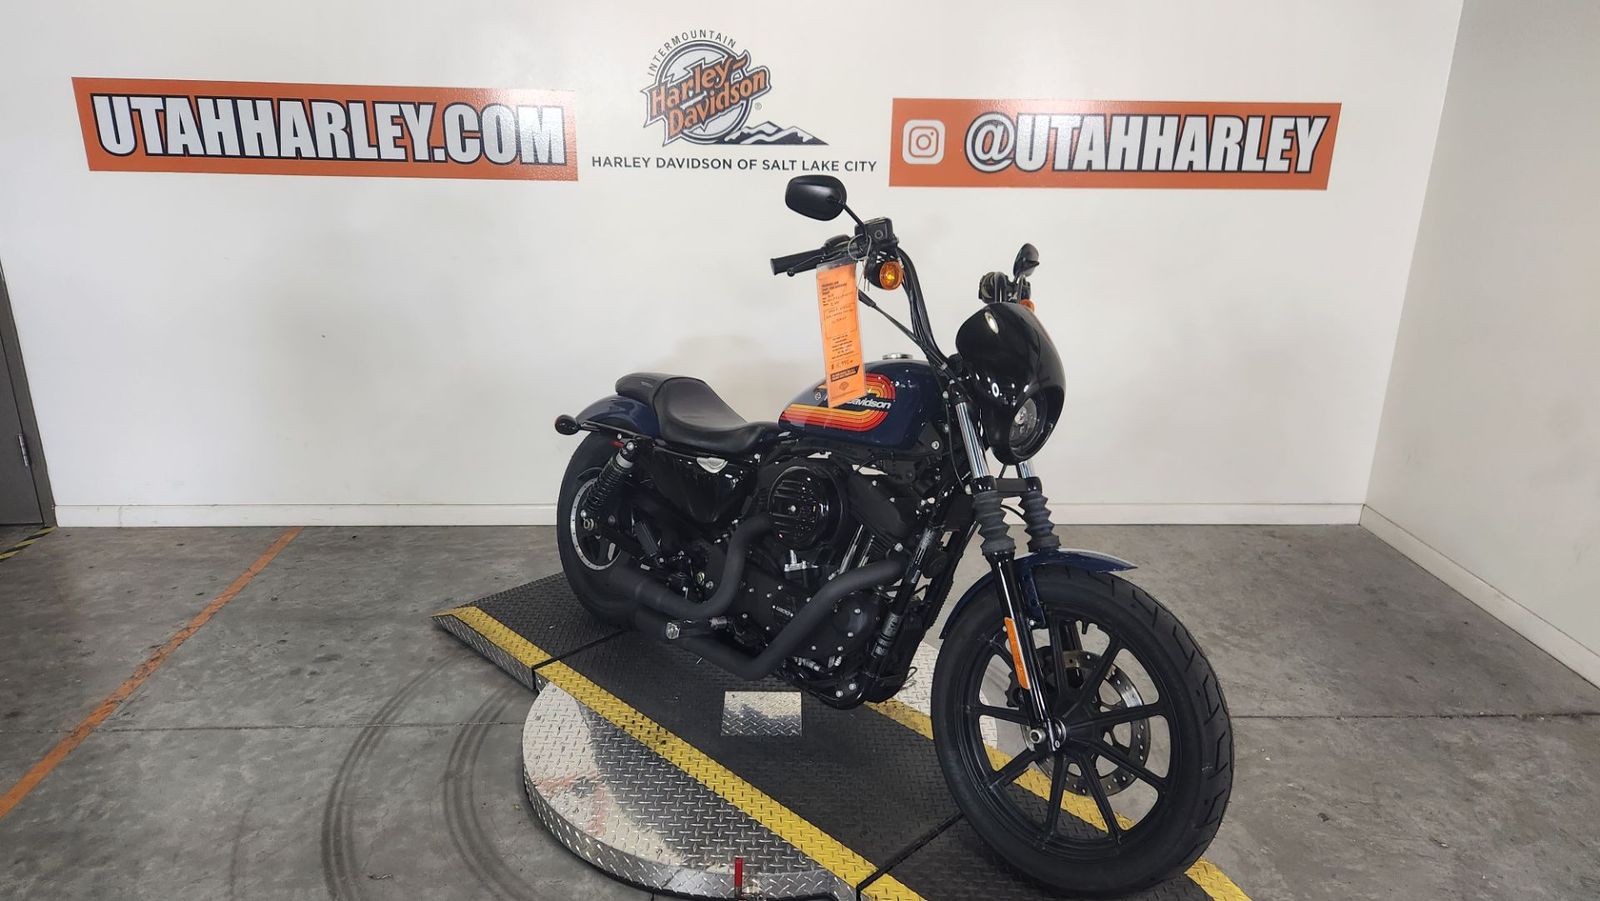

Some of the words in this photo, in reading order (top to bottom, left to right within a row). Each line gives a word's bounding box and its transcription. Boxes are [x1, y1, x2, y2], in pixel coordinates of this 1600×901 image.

[648, 29, 737, 77] INTERMOUNTAIN
[90, 92, 566, 166] UTAHHARLEY.COM
[668, 70, 768, 137] Davidson
[592, 156, 650, 169] HARLEY
[656, 157, 732, 170] DAVIDSON
[737, 159, 757, 170] OF
[762, 159, 797, 172] SALT
[801, 160, 839, 172] LAKE
[844, 160, 877, 172] CITY
[964, 111, 1328, 173] @UTAHHARLEY
